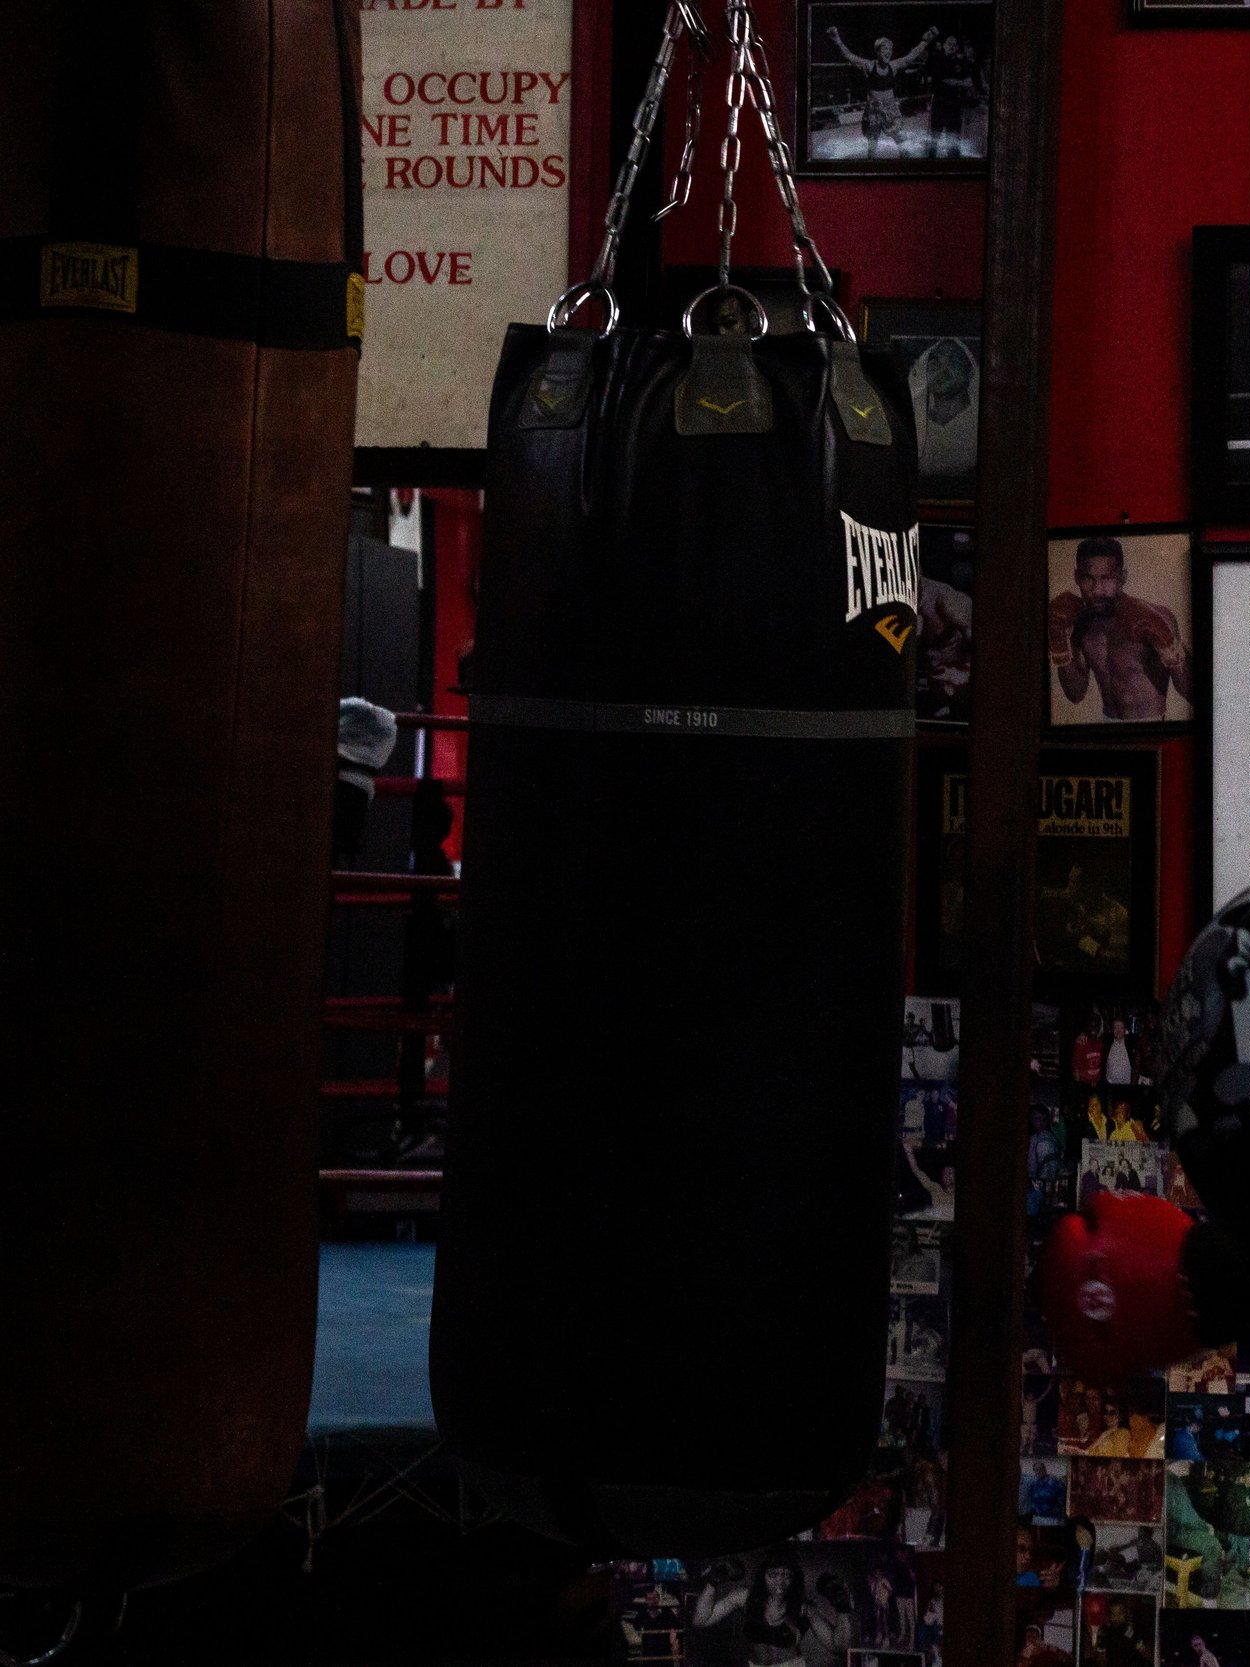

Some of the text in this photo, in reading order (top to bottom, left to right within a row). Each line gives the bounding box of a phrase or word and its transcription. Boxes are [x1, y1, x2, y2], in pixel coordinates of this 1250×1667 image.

[384, 72, 571, 105] OCCUPY
[362, 113, 540, 147] NE TIME
[385, 155, 566, 189] ROUNDS
[51, 251, 129, 300] EVERLAST
[361, 251, 472, 284] LOVE
[840, 510, 919, 623] EVERLAS
[644, 708, 718, 728] SINCE 1910
[1038, 780, 1123, 819] UGAR!
[1043, 822, 1085, 833] alonde
